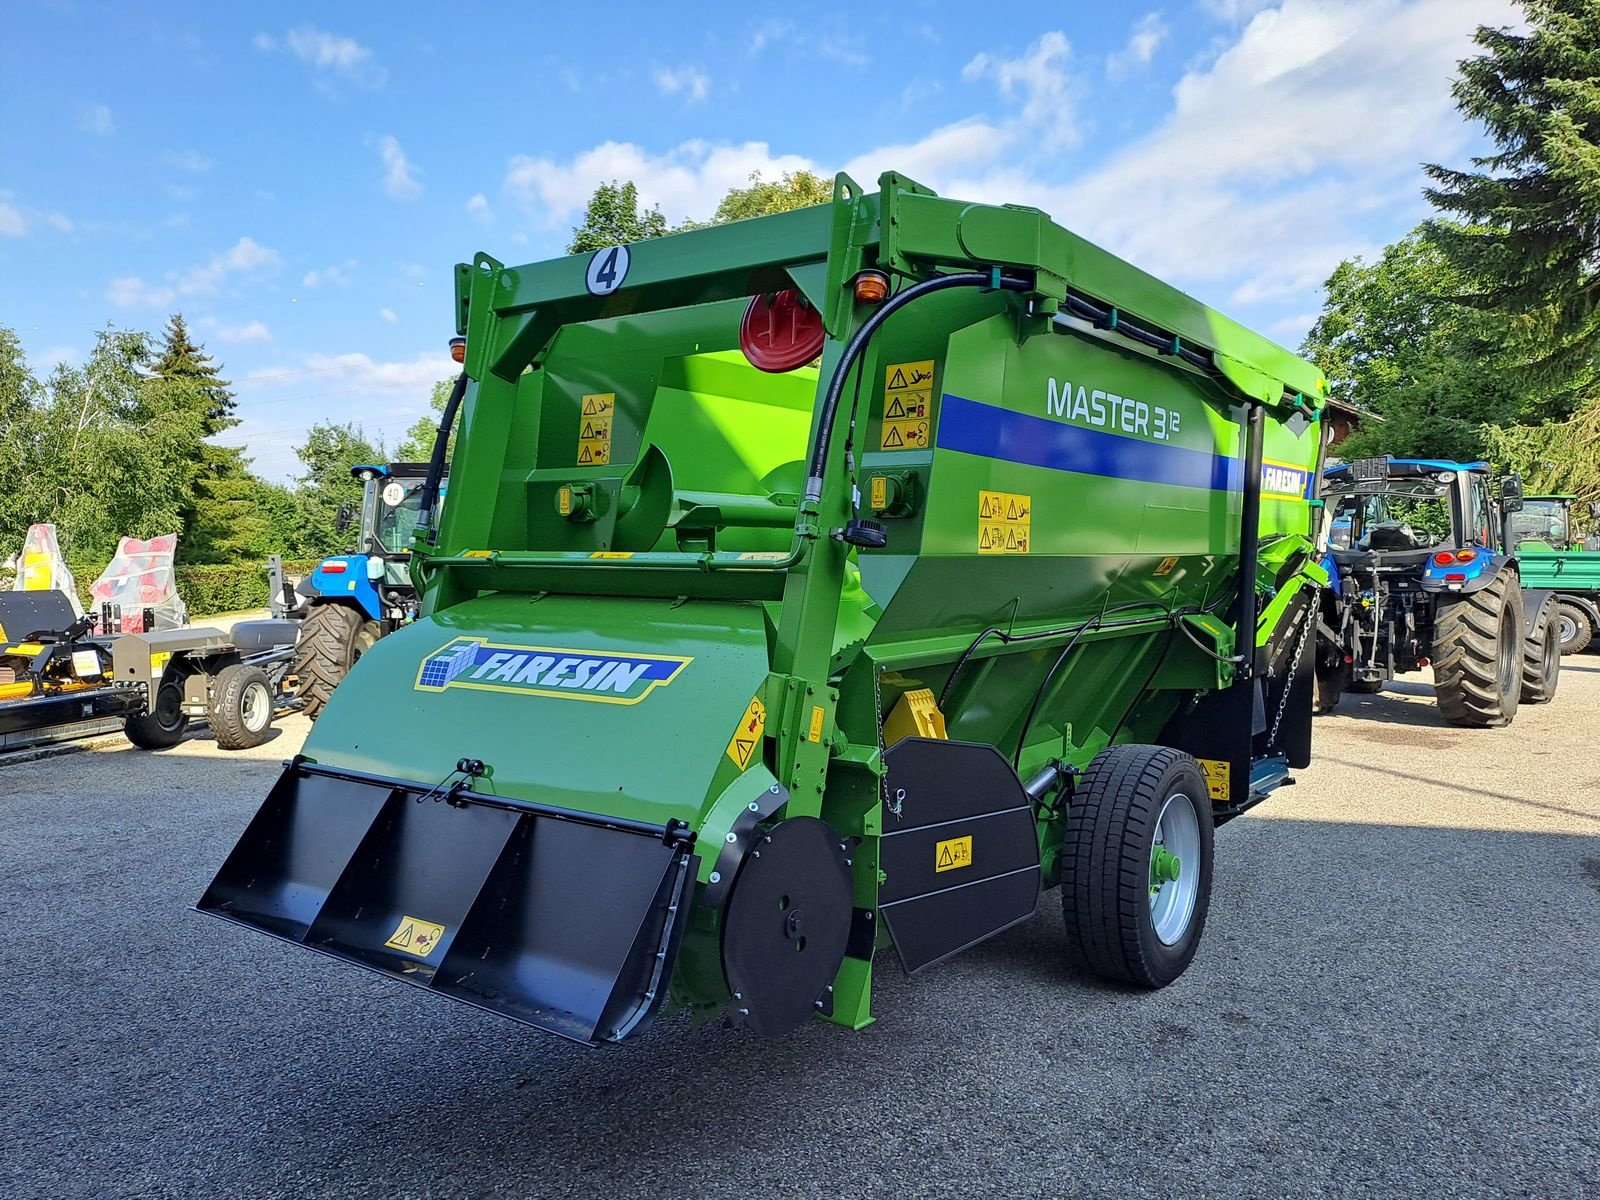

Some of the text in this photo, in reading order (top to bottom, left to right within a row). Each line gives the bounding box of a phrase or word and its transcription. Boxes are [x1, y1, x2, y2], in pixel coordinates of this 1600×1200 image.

[595, 246, 619, 289] 4
[1046, 376, 1149, 436] MASTER
[387, 488, 399, 501] 40
[1264, 467, 1302, 495] FARESIN
[469, 652, 653, 693] FARESIN
